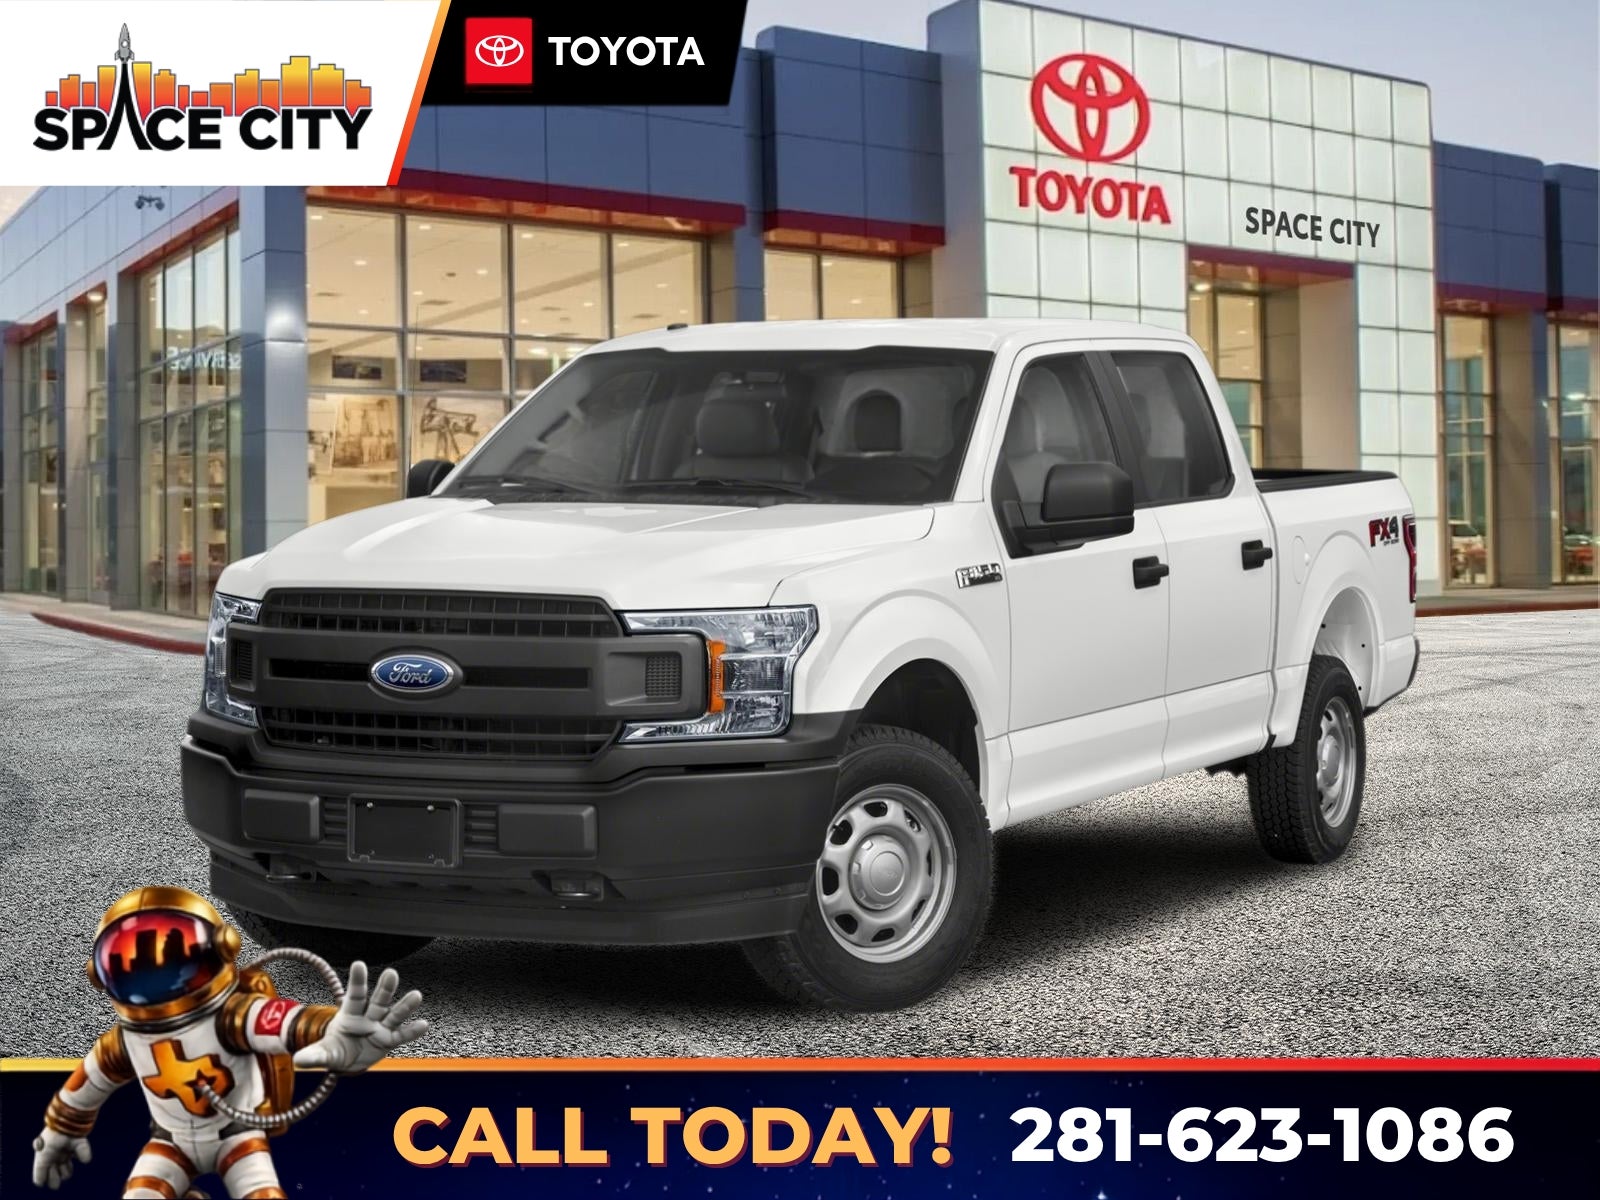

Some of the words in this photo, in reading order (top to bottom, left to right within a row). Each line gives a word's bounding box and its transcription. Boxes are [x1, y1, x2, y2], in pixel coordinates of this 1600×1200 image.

[1009, 166, 1171, 224] TOYOTA
[1245, 207, 1322, 242] SPACE
[1329, 217, 1381, 248] CITY
[1369, 515, 1399, 547] FX4
[389, 662, 432, 684] Ford
